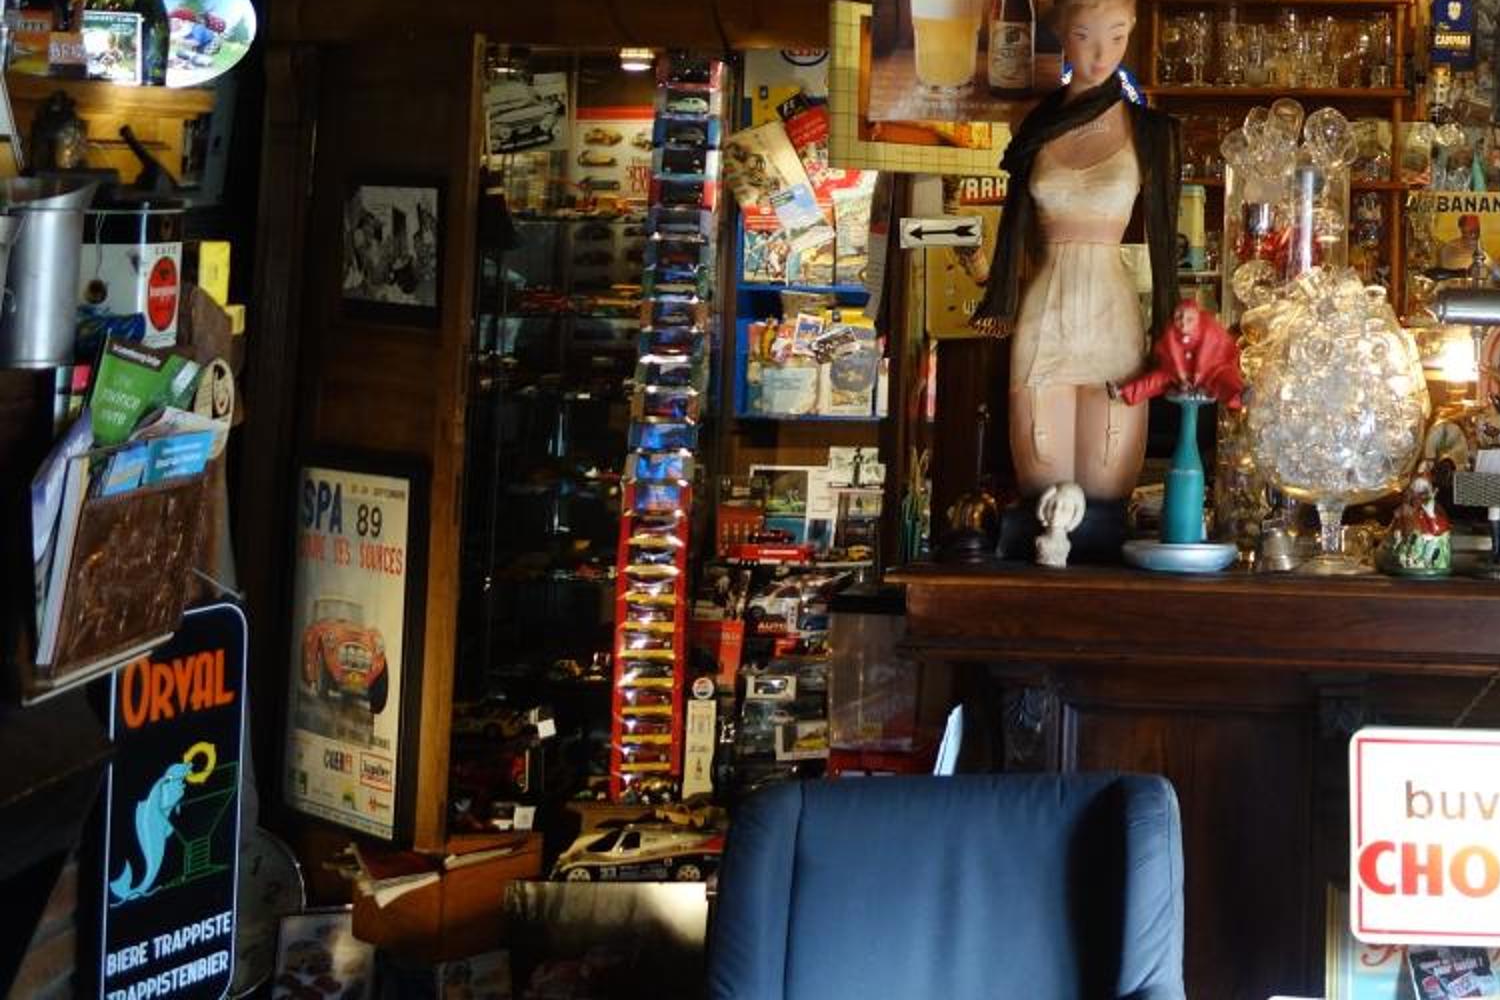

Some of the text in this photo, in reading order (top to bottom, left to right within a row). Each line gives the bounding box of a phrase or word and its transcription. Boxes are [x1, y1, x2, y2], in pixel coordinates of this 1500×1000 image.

[1433, 34, 1471, 47] CAMPARI
[303, 478, 383, 538] SPA 89
[120, 648, 236, 730] ORVAL
[153, 911, 233, 955] TRAPPISTE
